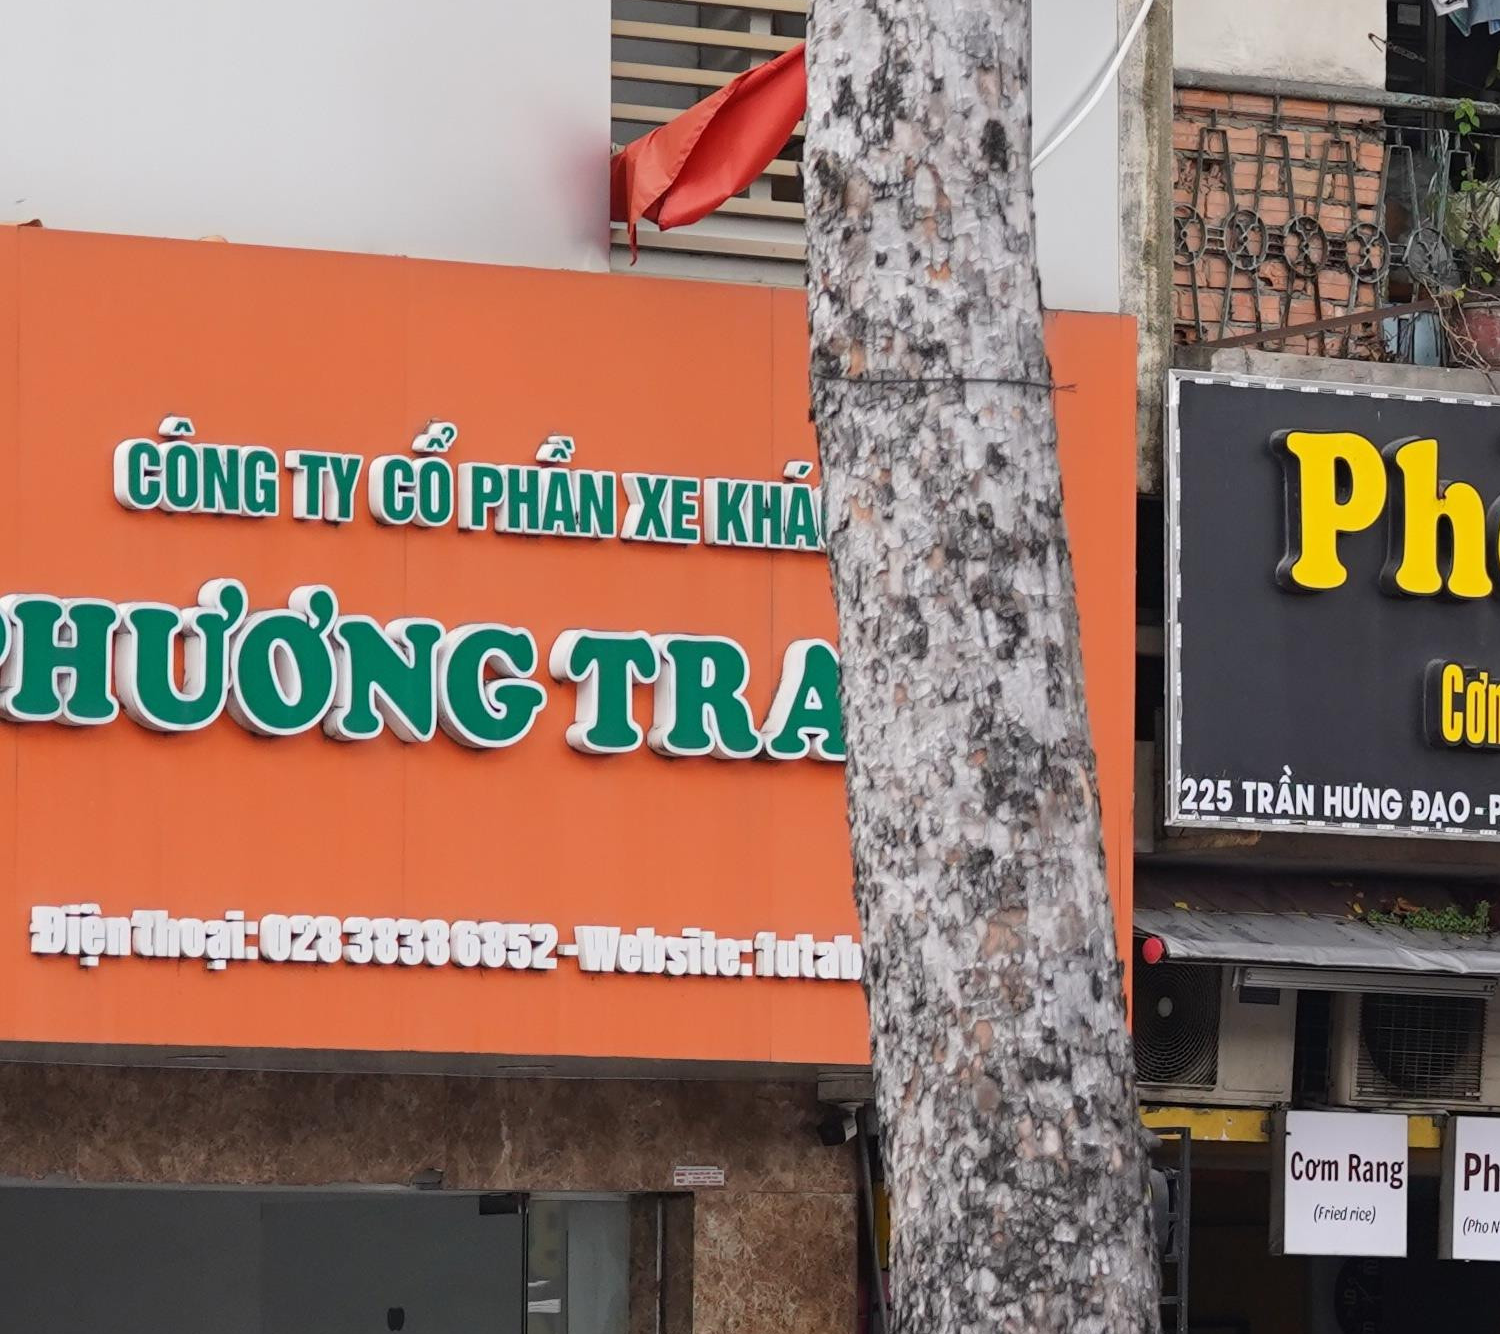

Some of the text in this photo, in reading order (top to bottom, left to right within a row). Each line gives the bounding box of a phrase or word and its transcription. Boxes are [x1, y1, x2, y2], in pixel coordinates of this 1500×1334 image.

[117, 415, 829, 551] CÔNG TY CỔ PHẦN XE KHÁ
[0, 577, 546, 751] HƯƠNG
[1180, 778, 1234, 813] 225
[1241, 764, 1316, 817] TRẦN
[1322, 779, 1403, 822] HƯNG
[30, 902, 132, 968] Điện
[132, 909, 259, 970] thoại:
[260, 913, 343, 964] 028
[343, 916, 450, 967] 3838
[451, 920, 559, 971] 6852
[575, 925, 753, 978] Website:
[1290, 1151, 1404, 1190] Cơm Rang
[1313, 1203, 1376, 1225] (Fried rice)
[1463, 1215, 1489, 1236] (Pho
